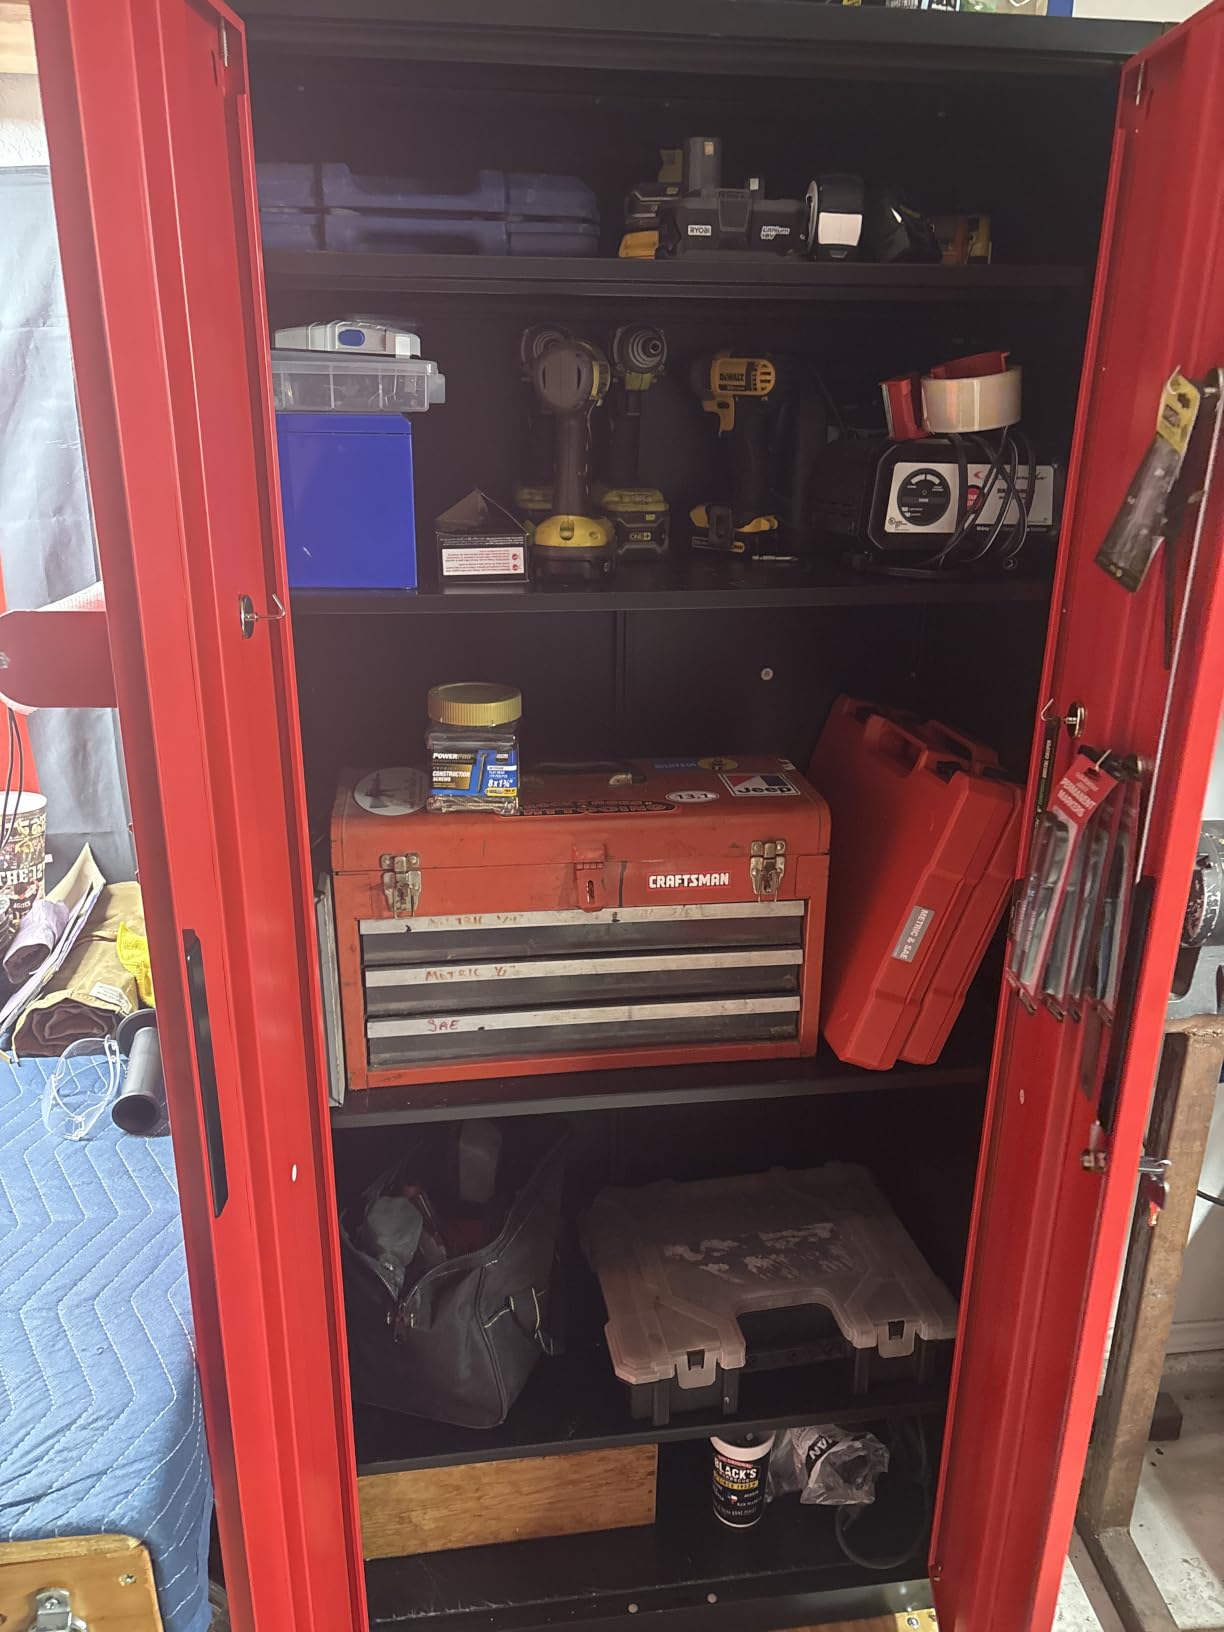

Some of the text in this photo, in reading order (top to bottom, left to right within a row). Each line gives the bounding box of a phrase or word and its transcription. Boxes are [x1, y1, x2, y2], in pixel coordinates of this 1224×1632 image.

[689, 226, 710, 235] RYOBI
[432, 752, 472, 760] POWERPRO
[432, 770, 471, 778] CONSTRUCTION
[737, 786, 792, 794] Jeep
[649, 873, 729, 889] CRAFTSMAN
[910, 909, 928, 936] METRIC
[900, 944, 912, 959] SAE
[427, 1019, 460, 1033] SAE
[714, 1456, 758, 1480] BLACK'S
